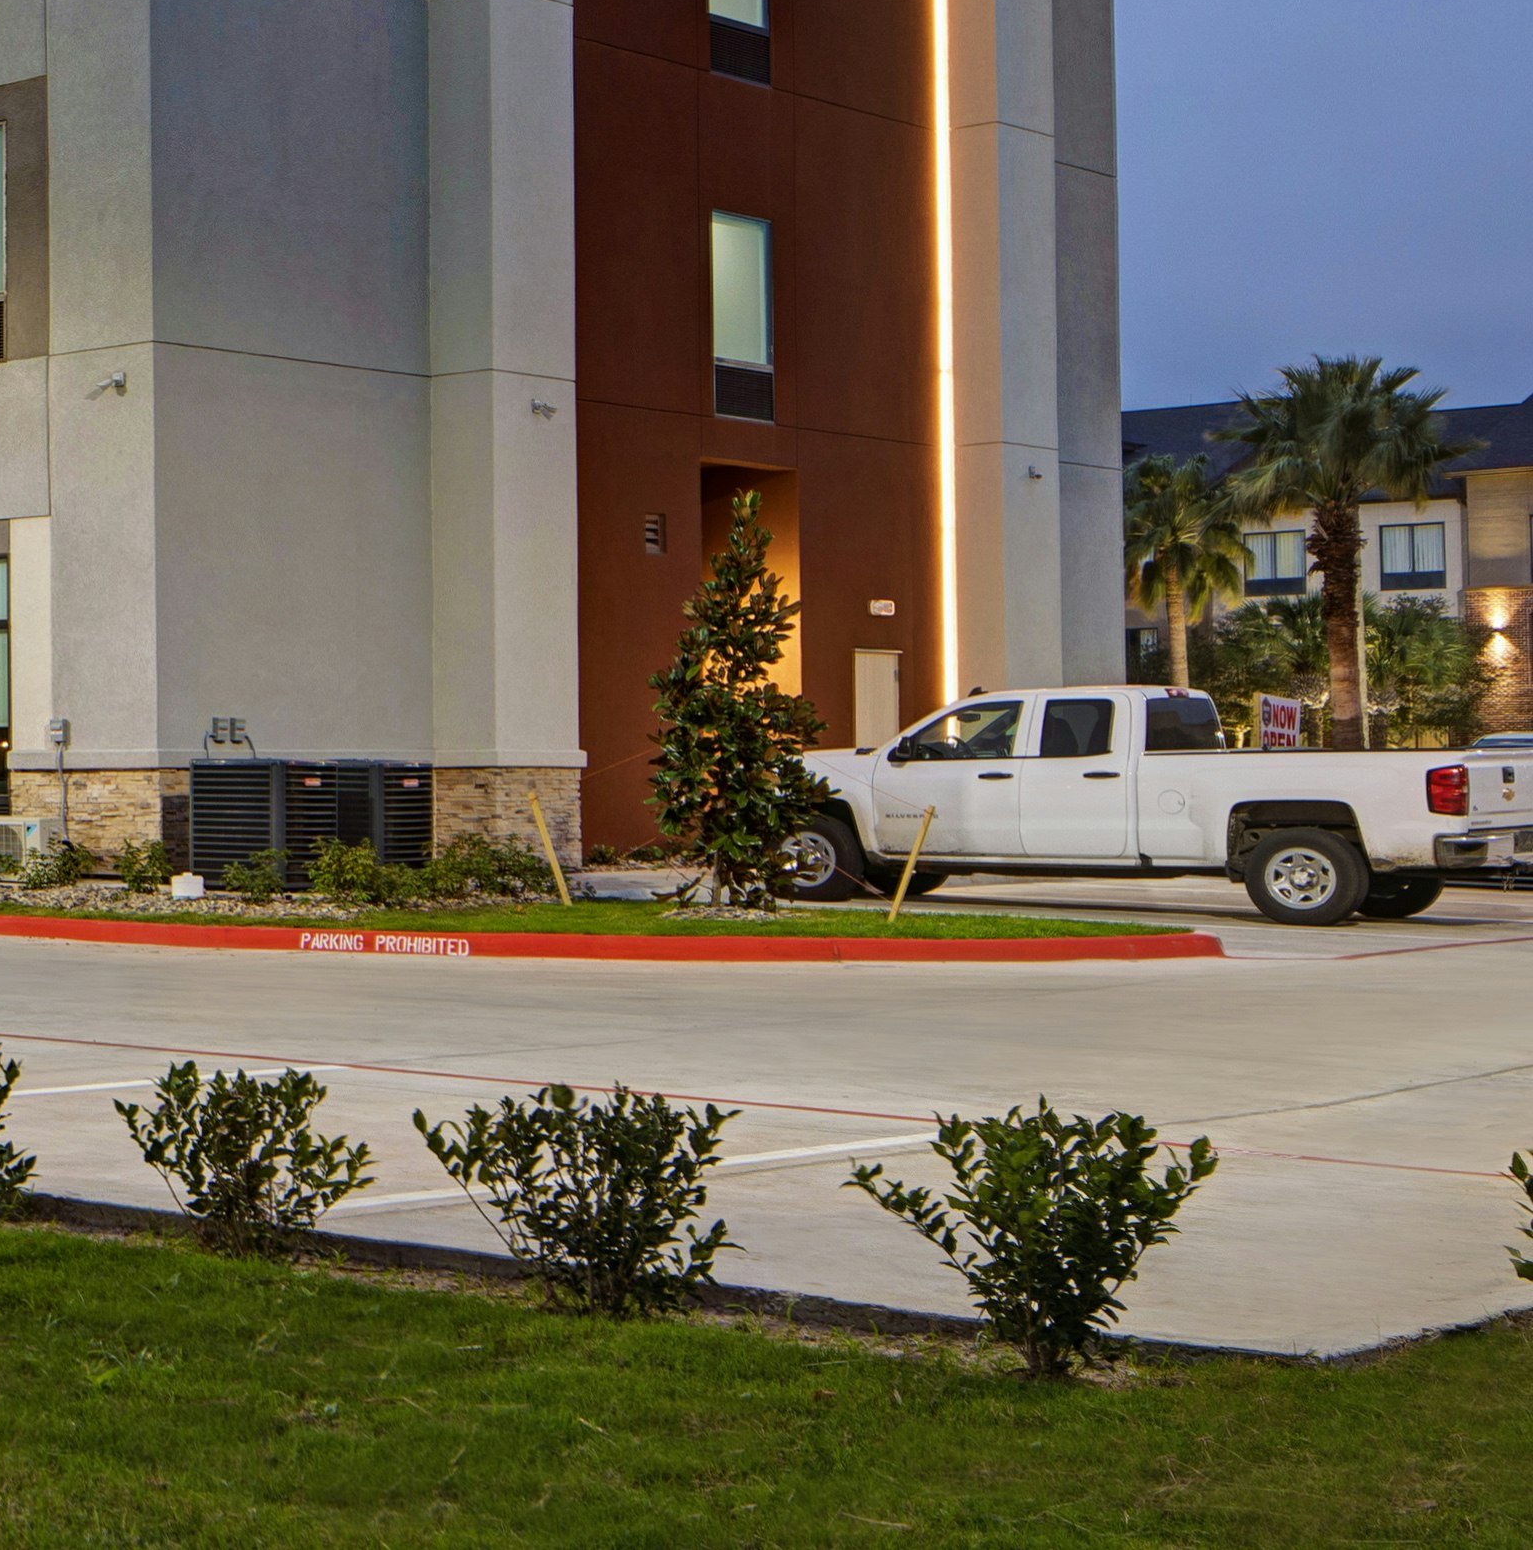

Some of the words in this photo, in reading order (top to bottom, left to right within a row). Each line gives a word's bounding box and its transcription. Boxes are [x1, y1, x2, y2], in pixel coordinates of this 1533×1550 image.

[1272, 703, 1297, 731] NOW
[1263, 730, 1296, 748] OPEN
[300, 932, 364, 951] PARKING
[375, 934, 470, 956] PROHIBITED
